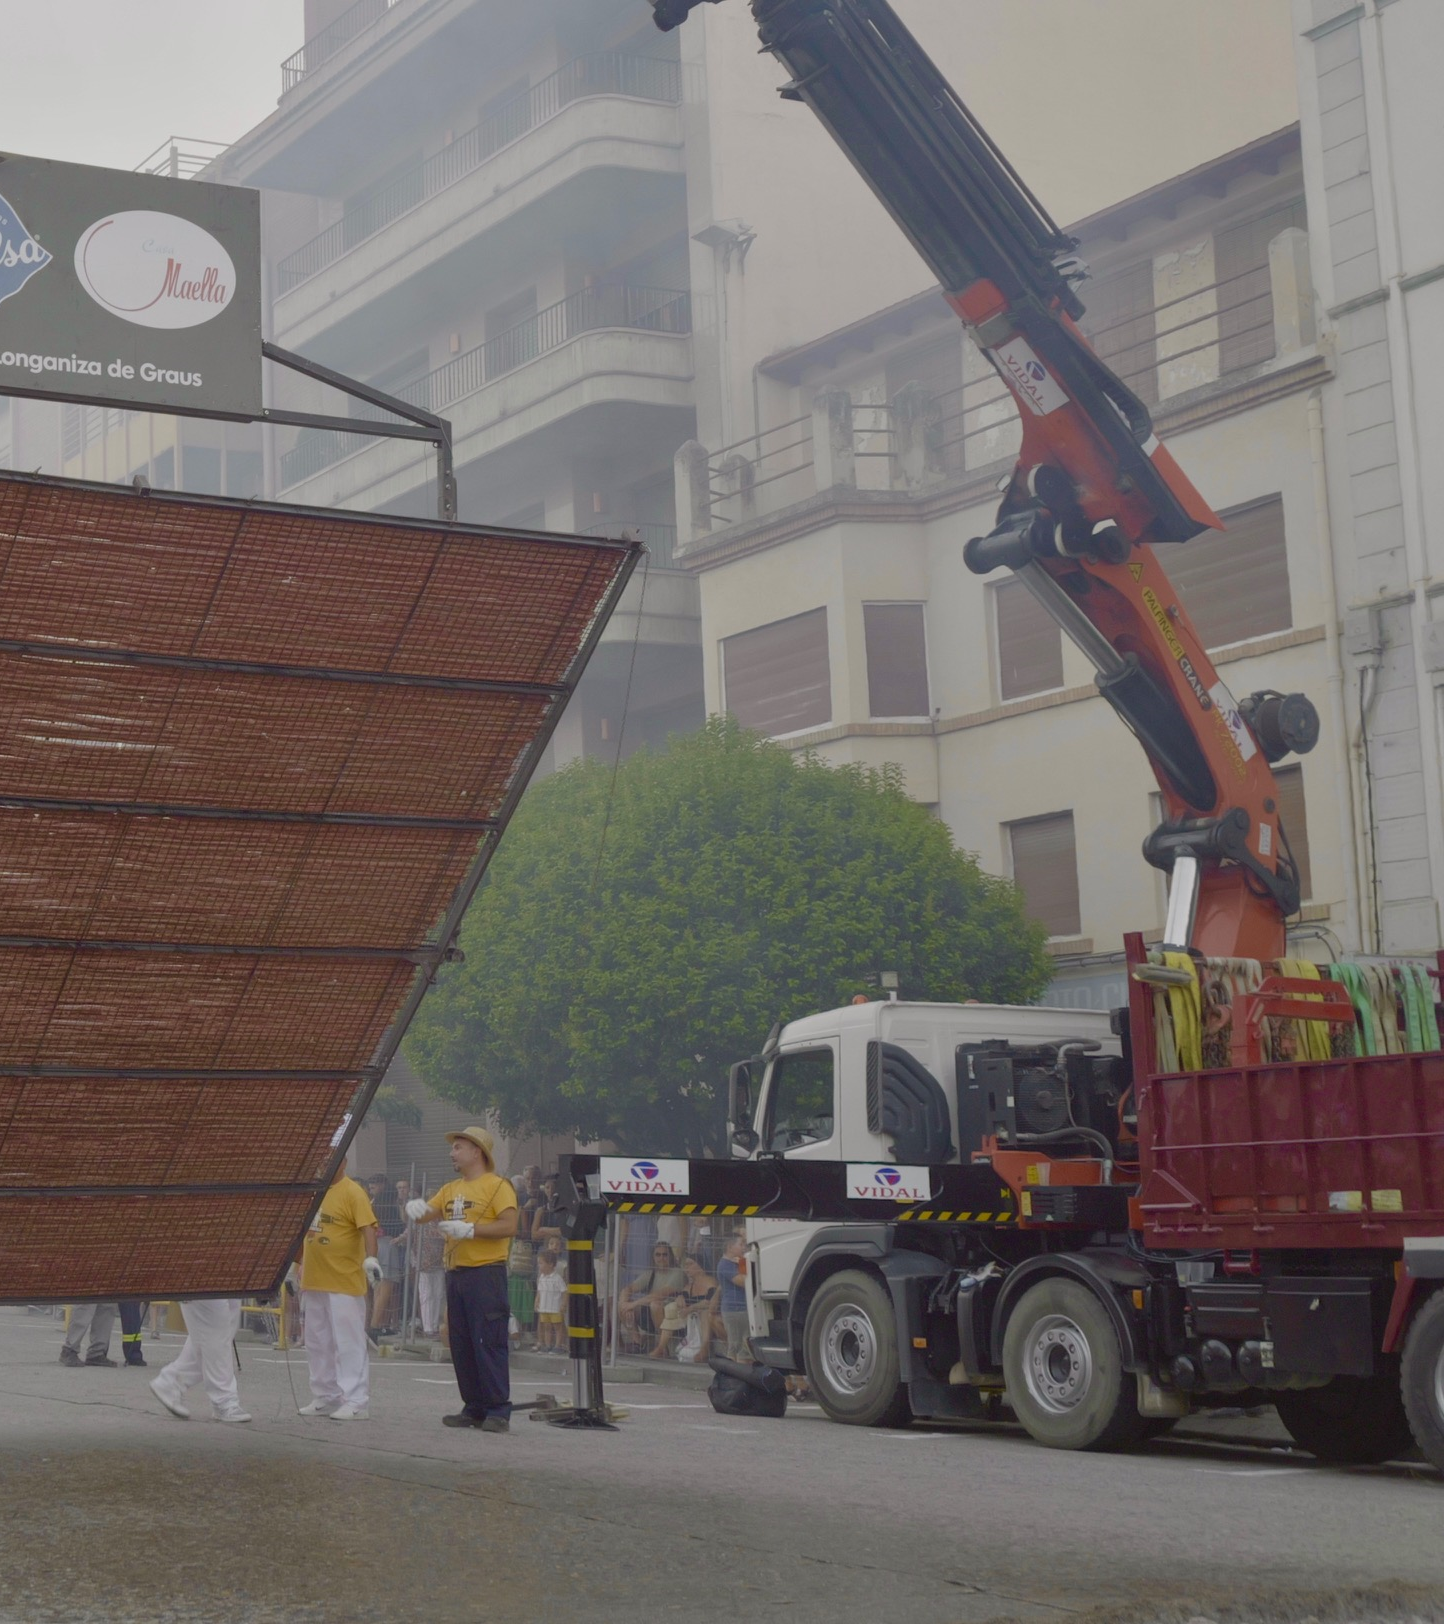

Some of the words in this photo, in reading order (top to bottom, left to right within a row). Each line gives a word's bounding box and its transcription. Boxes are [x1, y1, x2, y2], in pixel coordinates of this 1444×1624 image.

[163, 257, 227, 305] Maella
[107, 358, 135, 380] de
[139, 362, 203, 387] Graus
[1007, 353, 1044, 407] VIDAL
[1143, 590, 1184, 657] PALFINGER
[1179, 657, 1211, 706] CRANE
[607, 1180, 682, 1193] VIDAL
[854, 1186, 925, 1199] VIDAL
